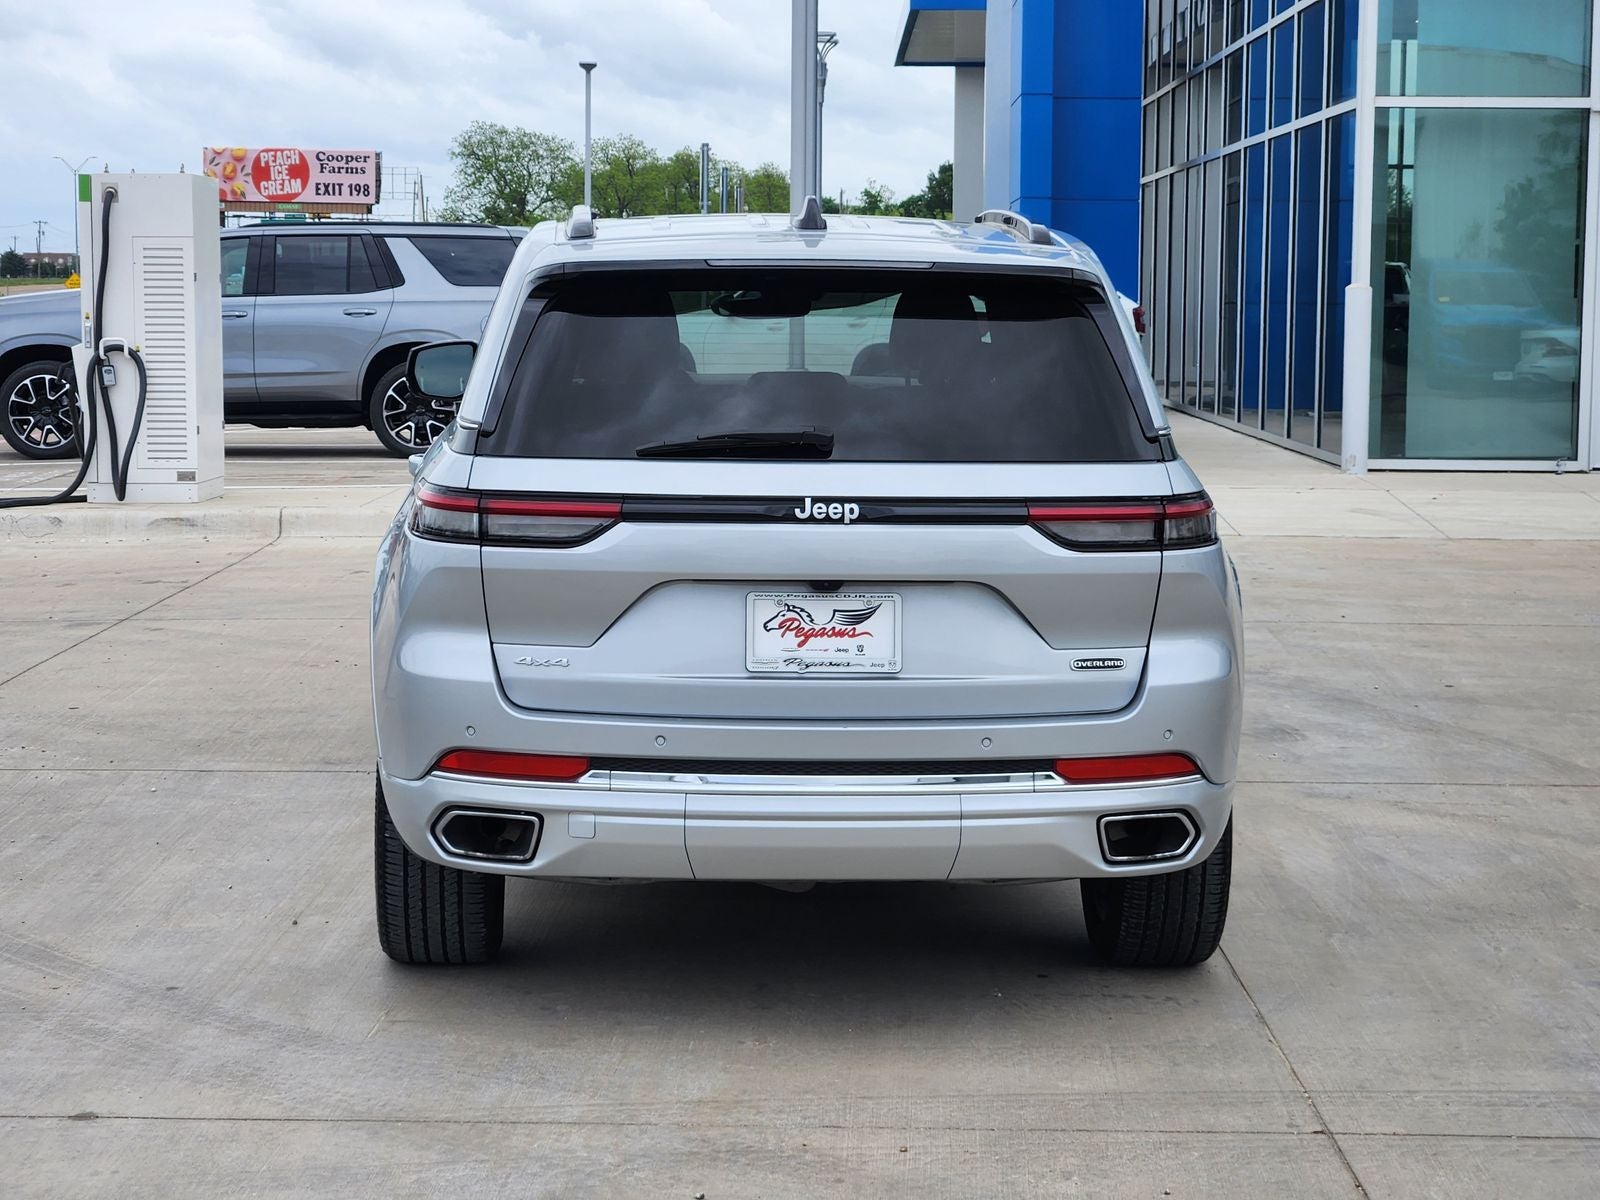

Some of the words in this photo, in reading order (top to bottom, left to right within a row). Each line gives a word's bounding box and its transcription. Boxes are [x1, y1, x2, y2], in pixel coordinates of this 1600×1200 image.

[260, 150, 299, 166] PEACH
[315, 151, 370, 165] Cooper
[270, 166, 289, 180] ICE
[319, 163, 366, 175] Farms
[260, 179, 302, 196] CREAM
[315, 182, 343, 196] EXIT
[348, 183, 370, 197] 198
[794, 497, 860, 524] Jeep
[778, 617, 874, 648] Pegasus
[514, 656, 571, 667] 4x4
[783, 657, 866, 670] Pegasus
